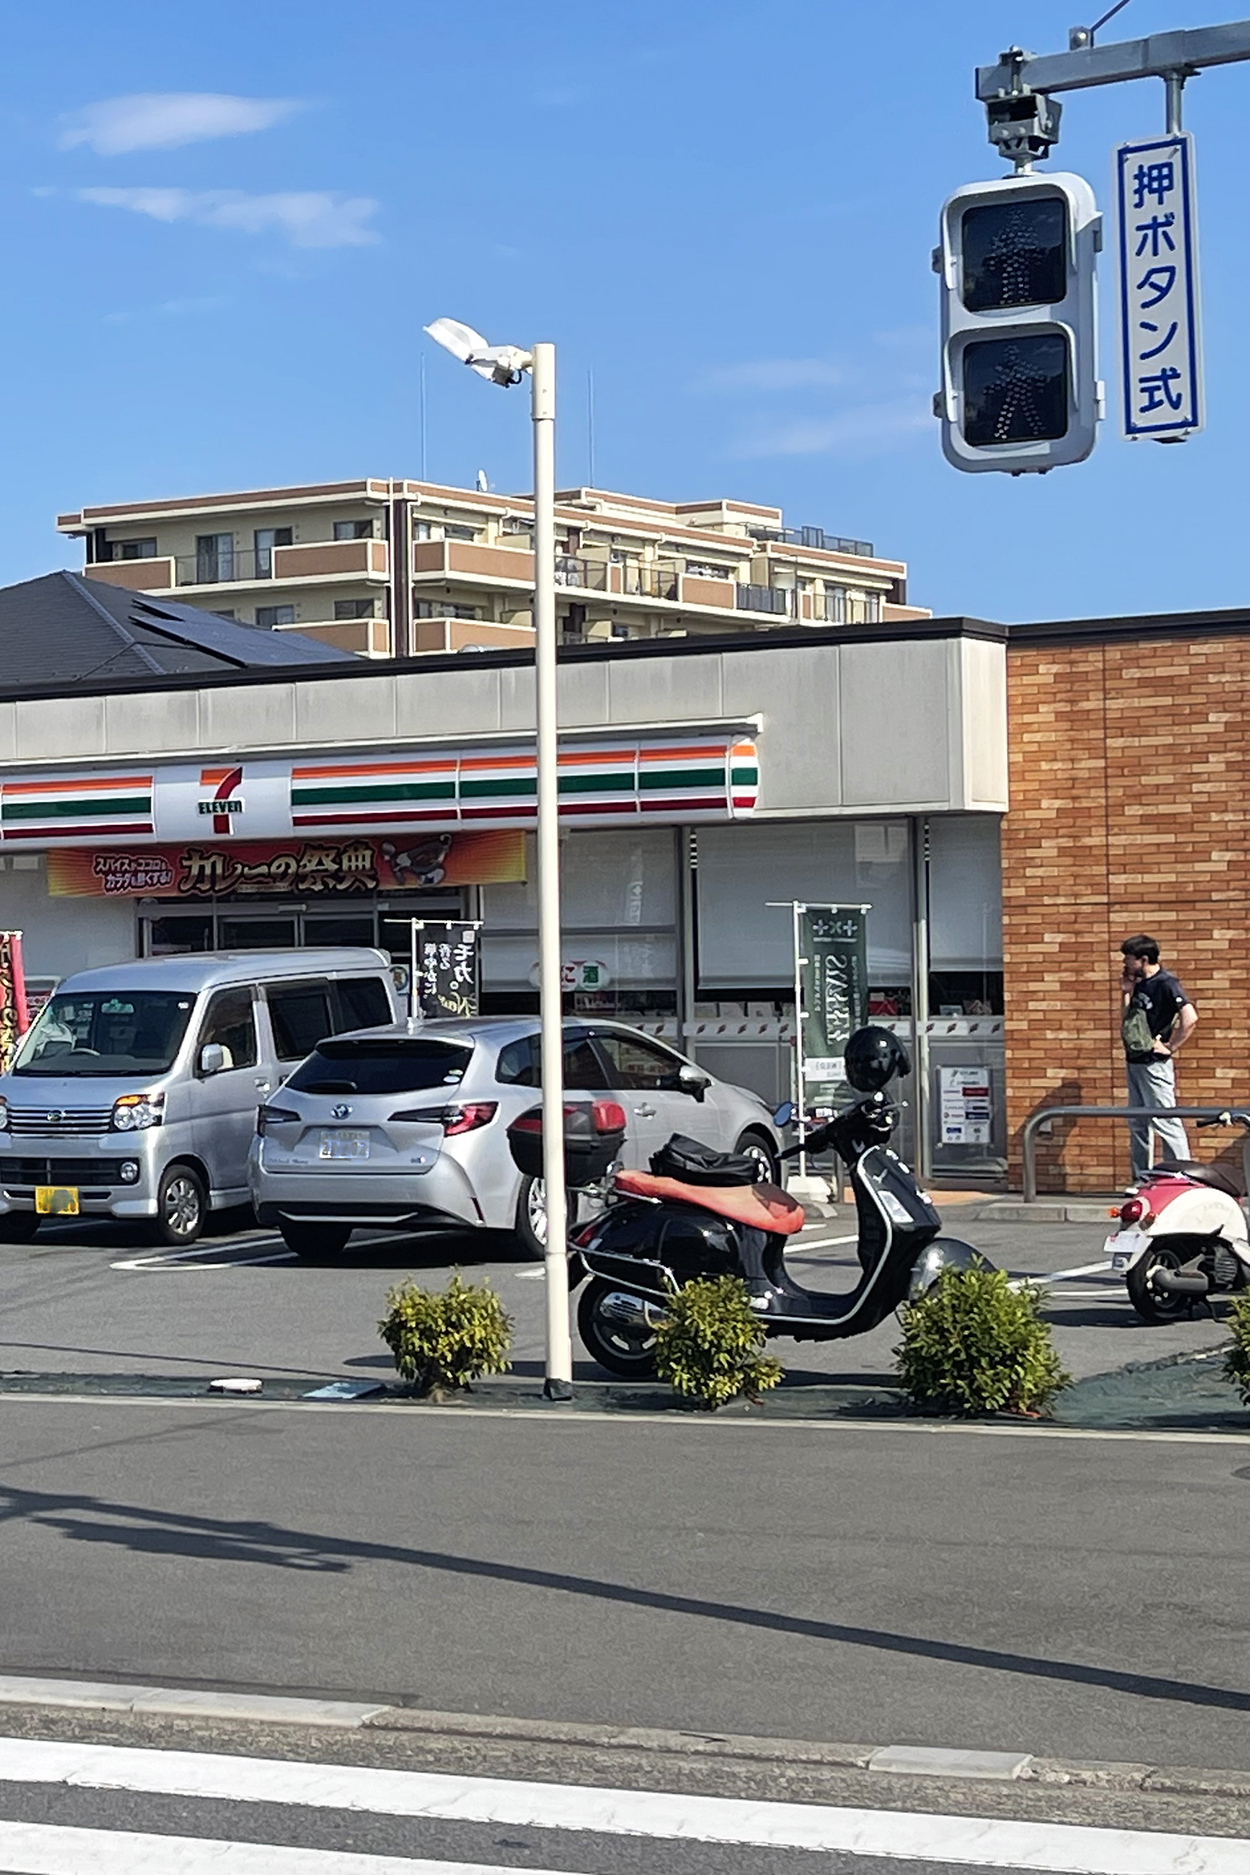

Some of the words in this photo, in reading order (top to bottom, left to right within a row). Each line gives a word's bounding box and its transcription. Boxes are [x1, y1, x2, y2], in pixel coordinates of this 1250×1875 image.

[1133, 161, 1183, 414] 押ボタン式
[200, 766, 243, 834] 7
[180, 843, 377, 891] カレーの祭典
[582, 965, 600, 984] 酒
